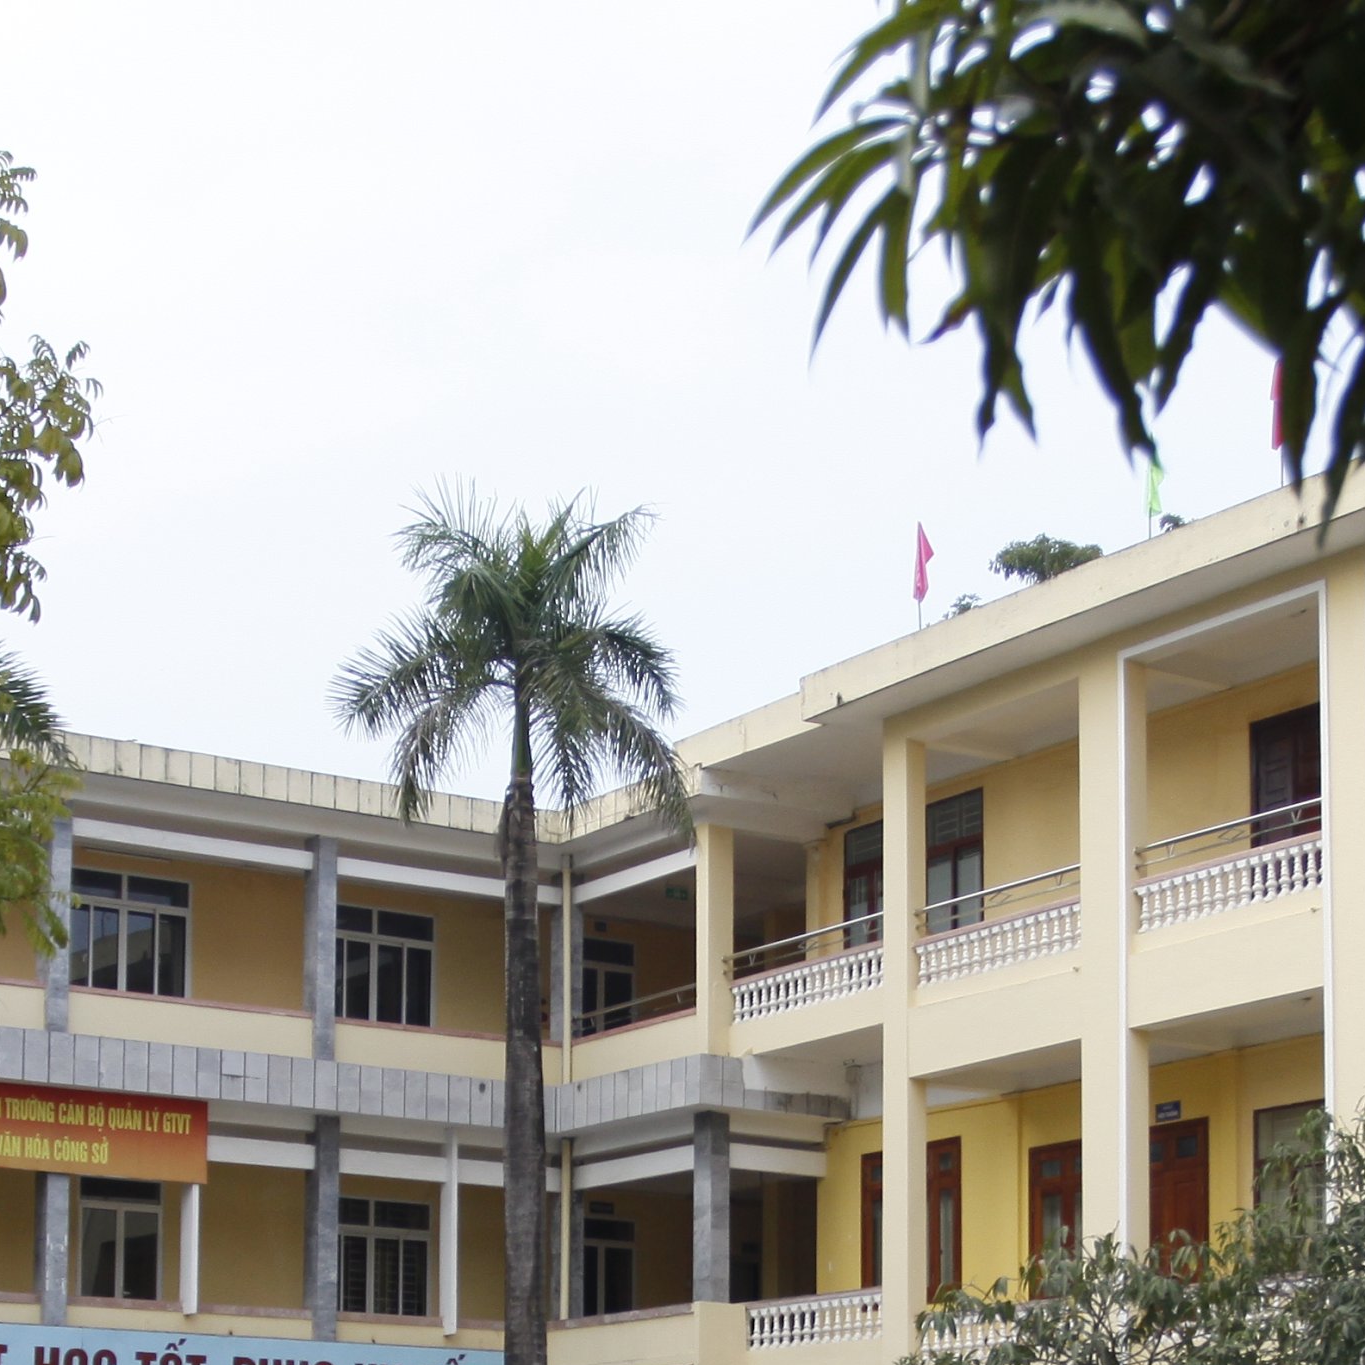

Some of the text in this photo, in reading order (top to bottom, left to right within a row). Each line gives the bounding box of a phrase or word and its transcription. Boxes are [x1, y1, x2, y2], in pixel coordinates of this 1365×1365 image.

[5, 1093, 55, 1123] TRƯỜNG
[88, 1101, 105, 1132] BỘ
[108, 1102, 142, 1131] QUẢN
[145, 1106, 160, 1132] LÝ
[163, 1112, 192, 1135] GTVT
[25, 1132, 50, 1160] HÓA
[54, 1136, 88, 1162] CÔNG
[91, 1135, 109, 1164] SỞ
